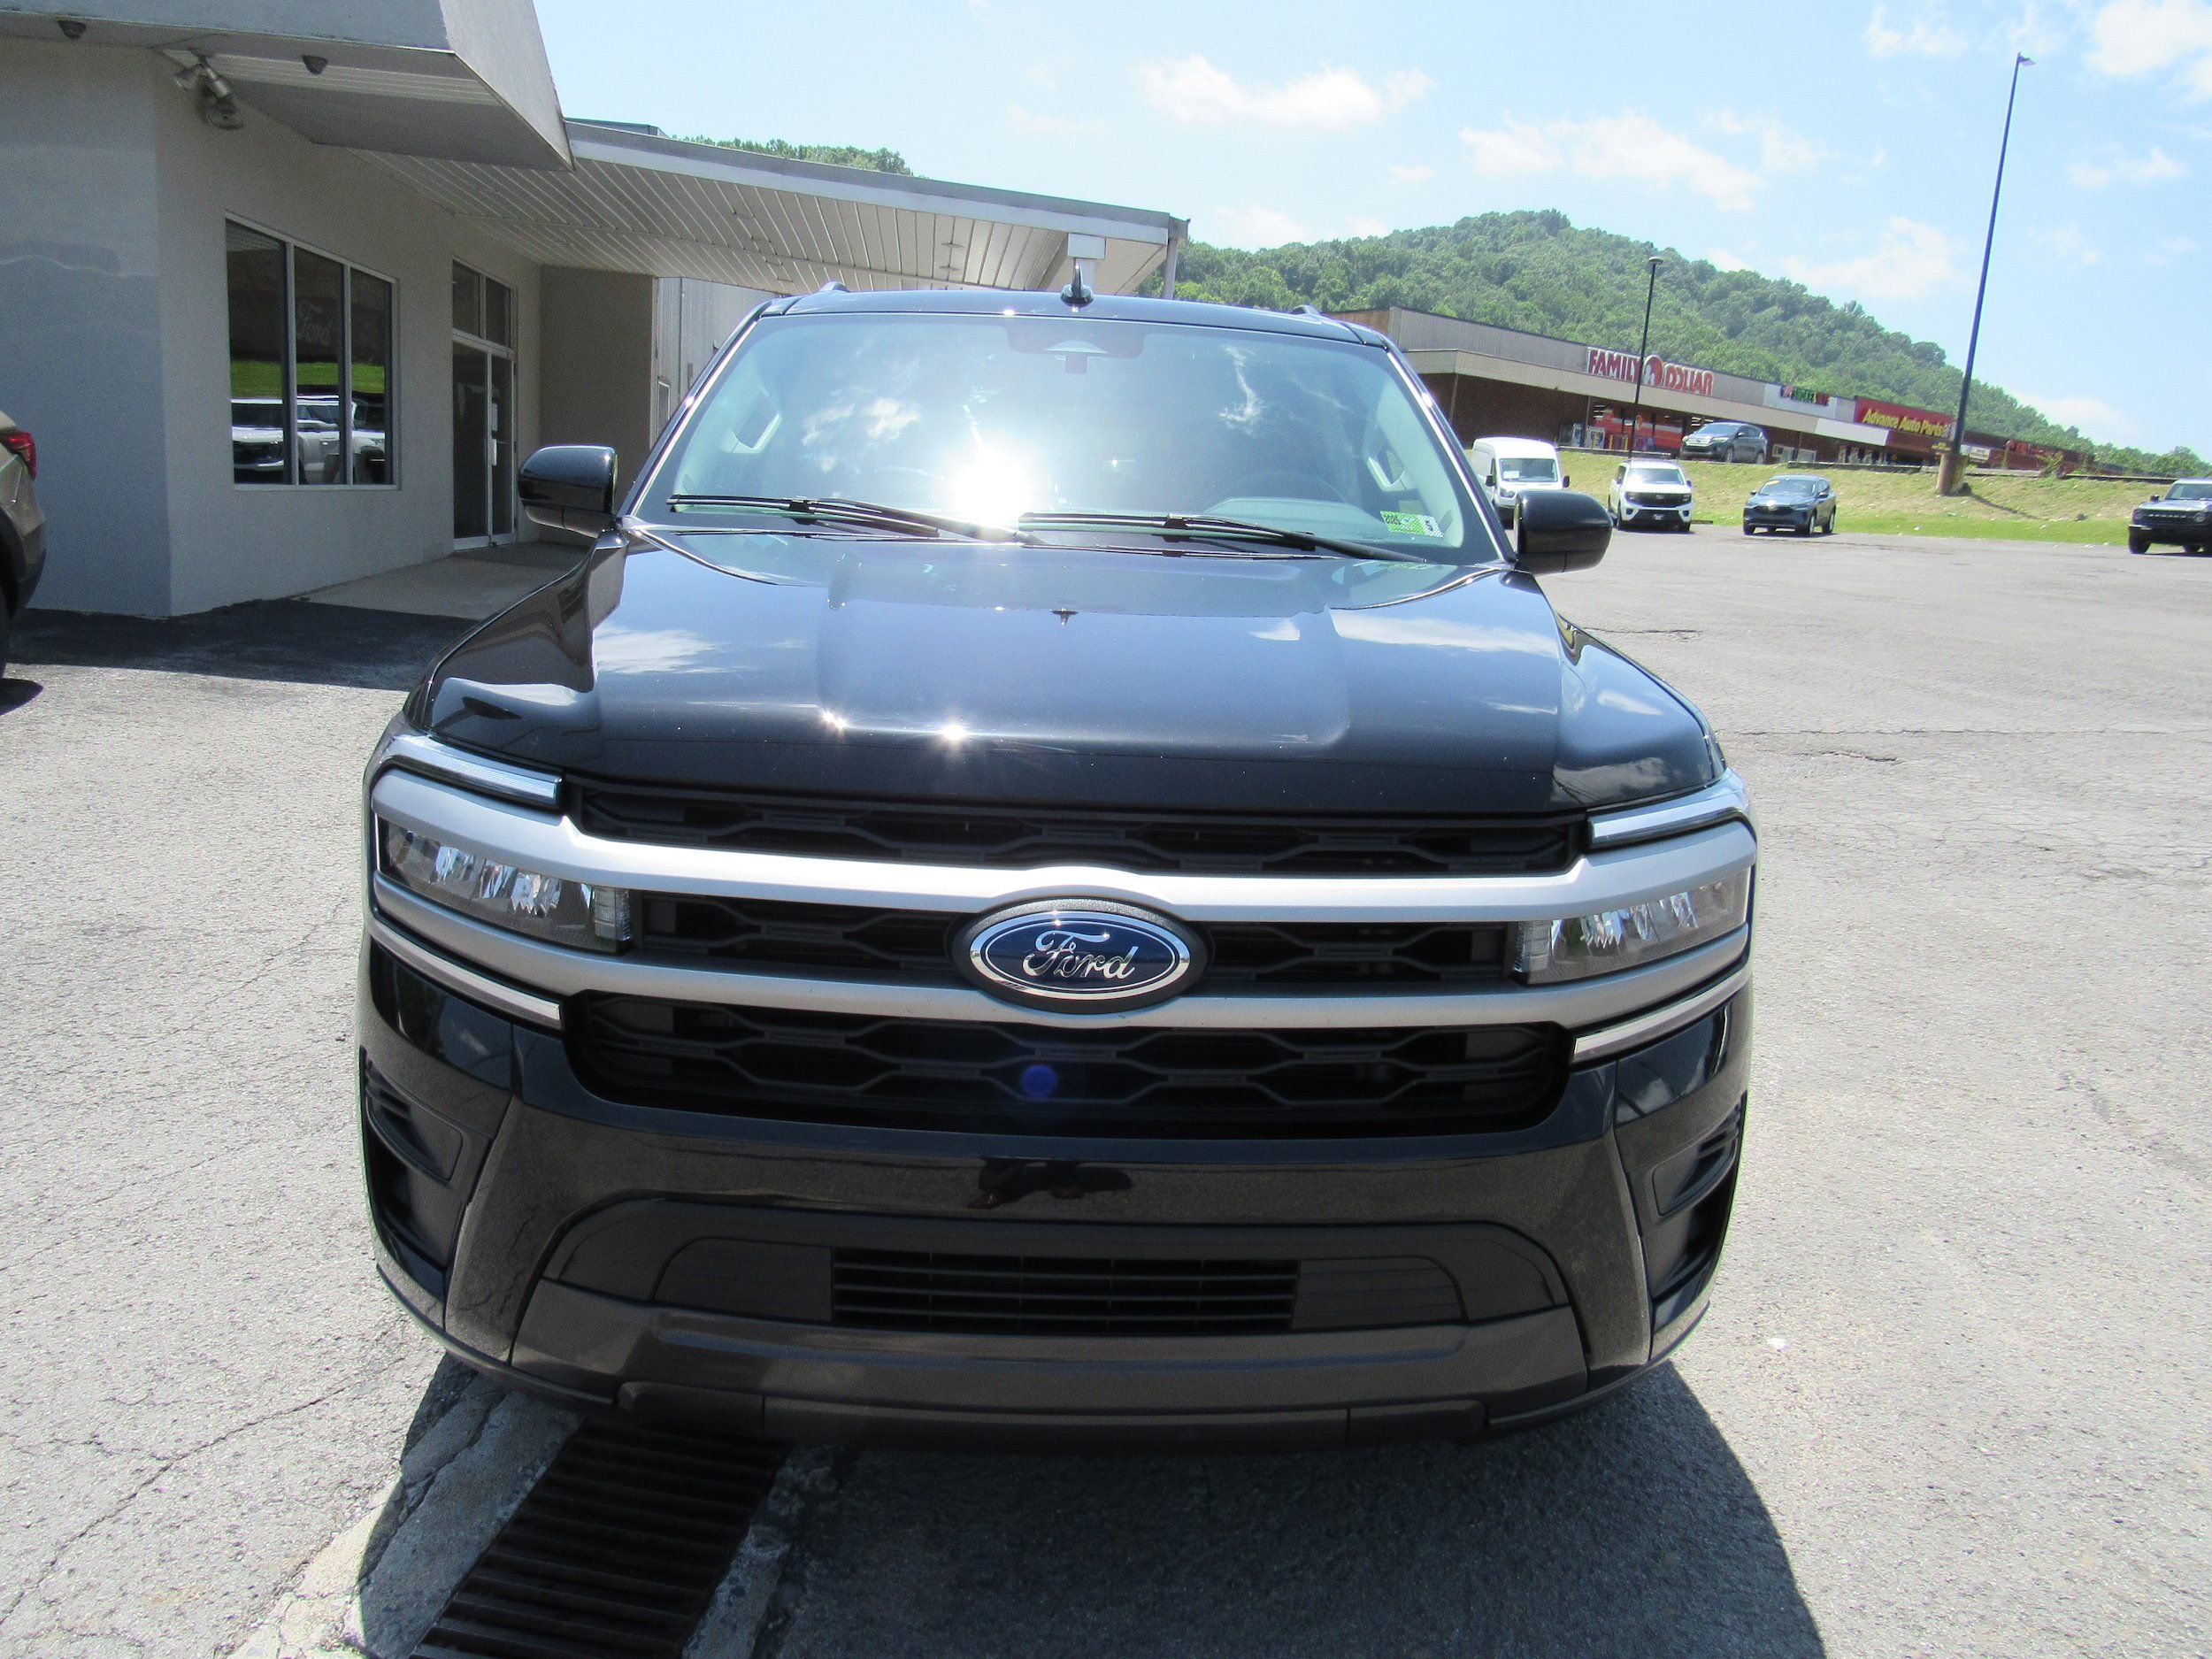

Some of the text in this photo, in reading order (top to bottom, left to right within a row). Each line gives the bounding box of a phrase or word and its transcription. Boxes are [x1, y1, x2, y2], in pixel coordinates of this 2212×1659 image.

[1587, 346, 1714, 396] FAMILY DOLLAR
[1862, 408, 1900, 428] Advance
[1898, 416, 1921, 433] Auto
[1022, 929, 1139, 979] Ford
